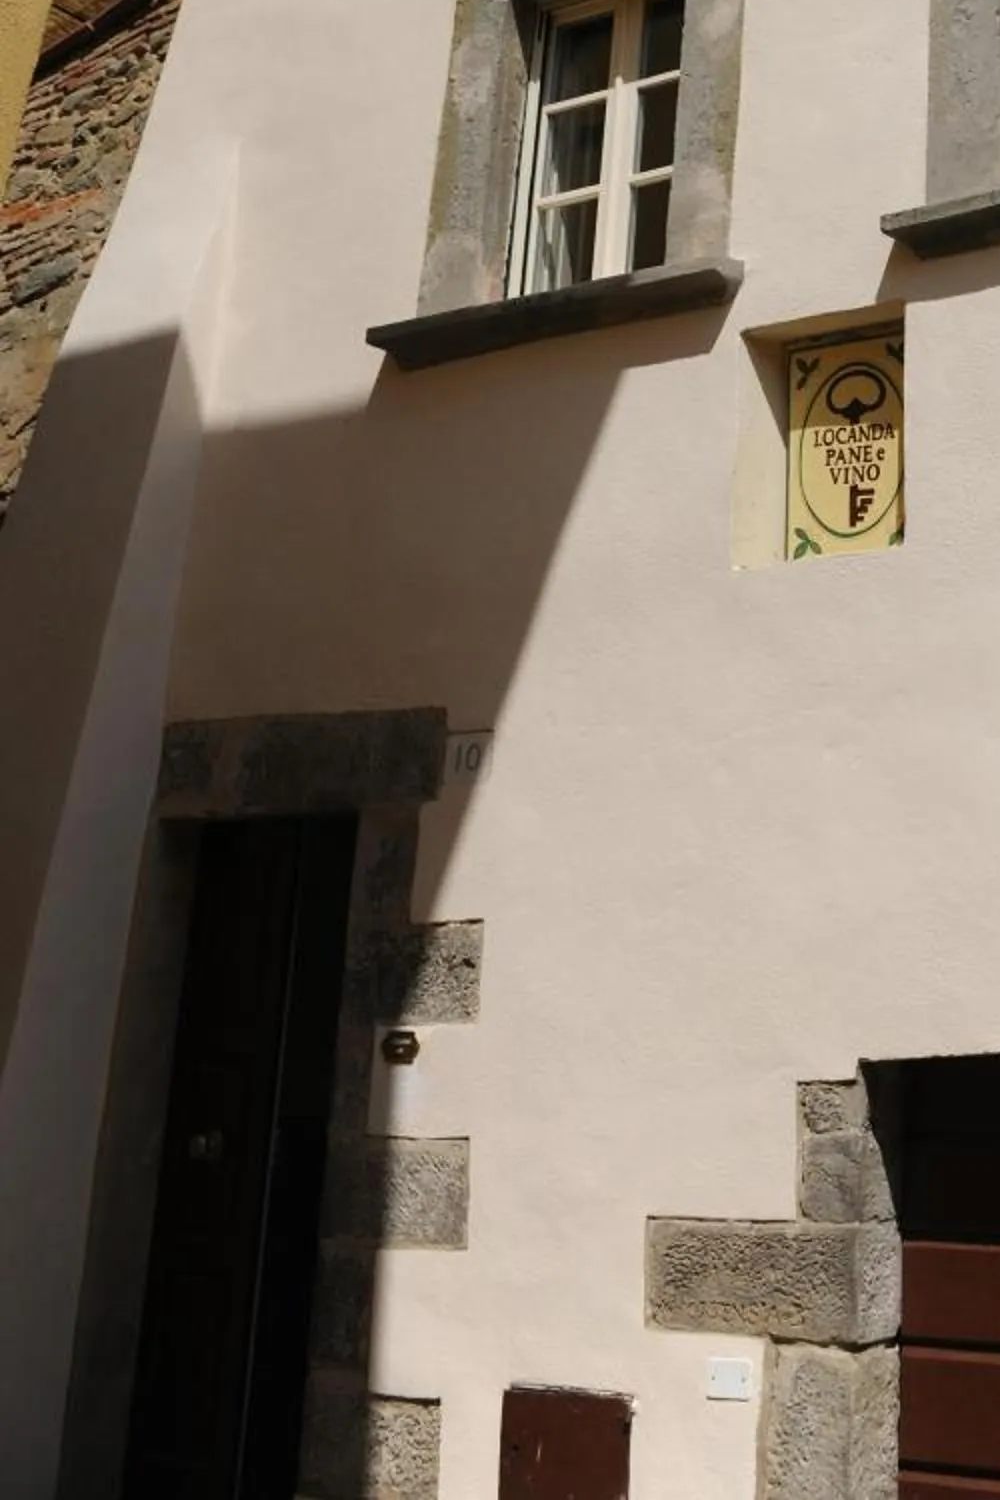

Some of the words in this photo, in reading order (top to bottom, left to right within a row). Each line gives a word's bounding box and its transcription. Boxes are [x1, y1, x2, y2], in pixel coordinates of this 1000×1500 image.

[813, 422, 896, 448] LOCANDA
[825, 445, 873, 467] PANE
[876, 447, 886, 461] e
[829, 463, 881, 485] VINO
[454, 743, 482, 775] 10
